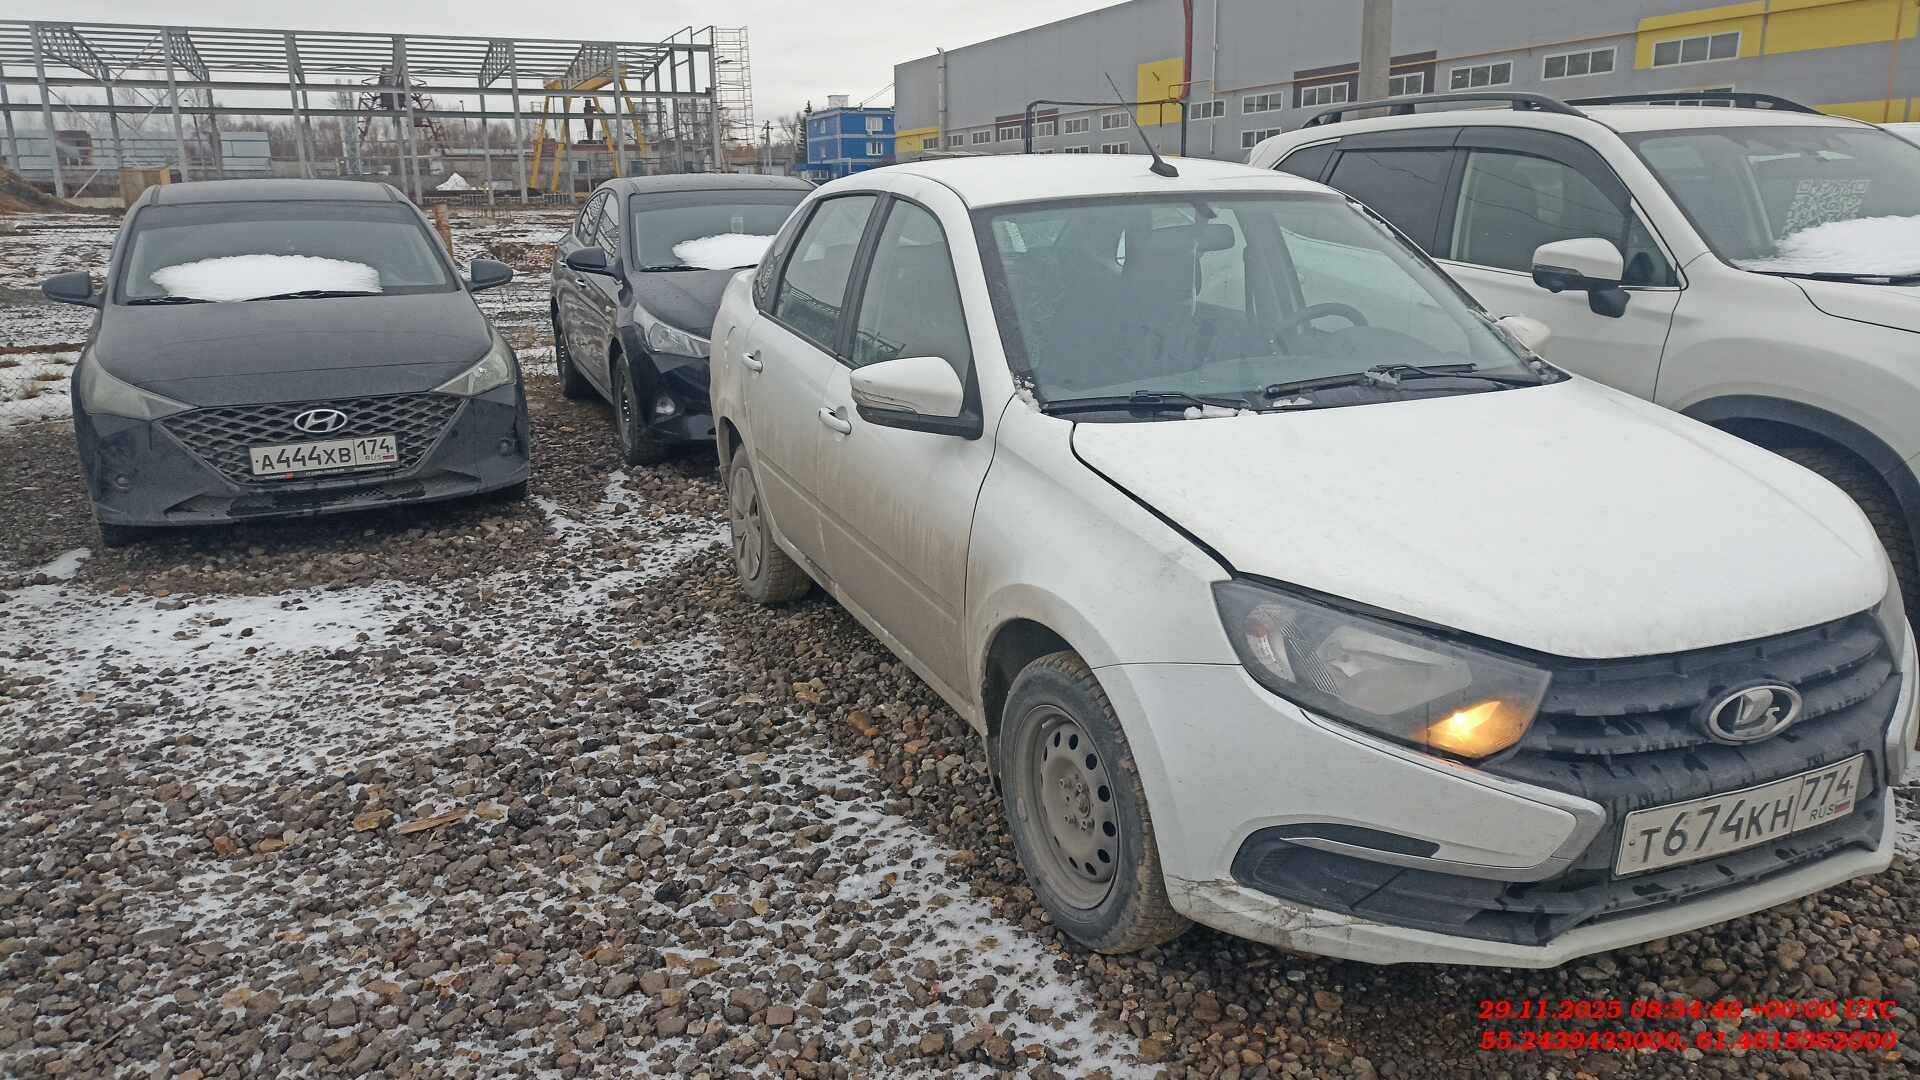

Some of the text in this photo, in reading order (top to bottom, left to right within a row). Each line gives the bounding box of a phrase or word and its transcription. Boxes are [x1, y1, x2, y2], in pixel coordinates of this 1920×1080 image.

[261, 438, 390, 470] А444ХВ 174
[1640, 765, 1853, 862] Т674КН 774
[1809, 804, 1835, 821] RUS
